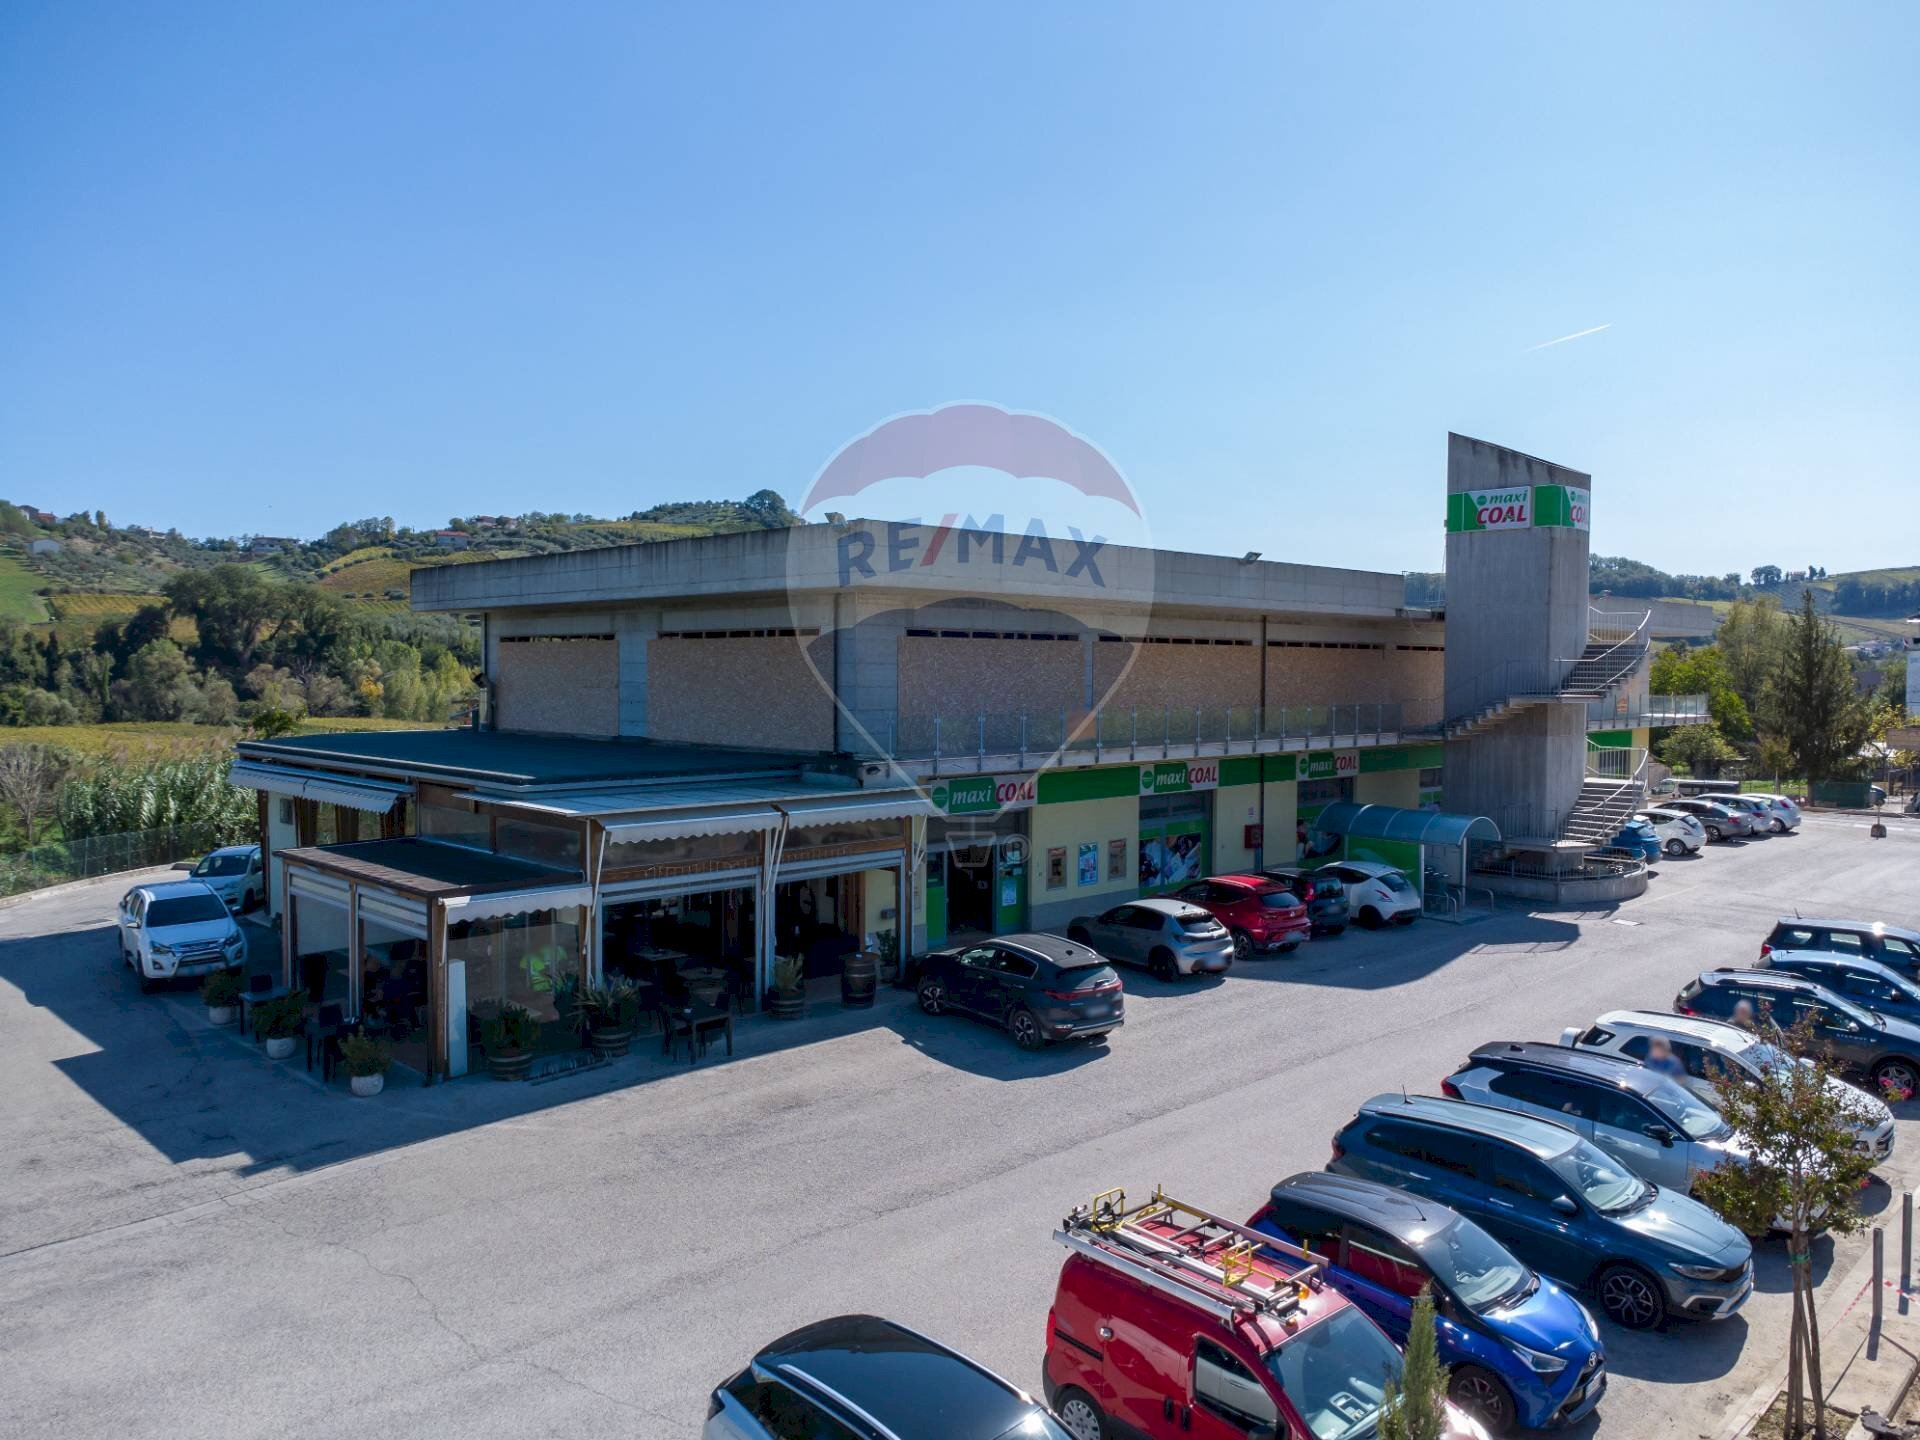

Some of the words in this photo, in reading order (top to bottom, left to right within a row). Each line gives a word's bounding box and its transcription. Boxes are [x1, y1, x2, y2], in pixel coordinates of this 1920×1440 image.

[1490, 490, 1527, 504] maxi
[1477, 505, 1527, 524] COAL
[1310, 757, 1334, 774] maxi
[1334, 755, 1358, 771] COAL
[1156, 769, 1187, 788] maxi
[1188, 766, 1217, 784] COAL
[951, 785, 993, 806] maxi
[995, 781, 1035, 802] COAL
